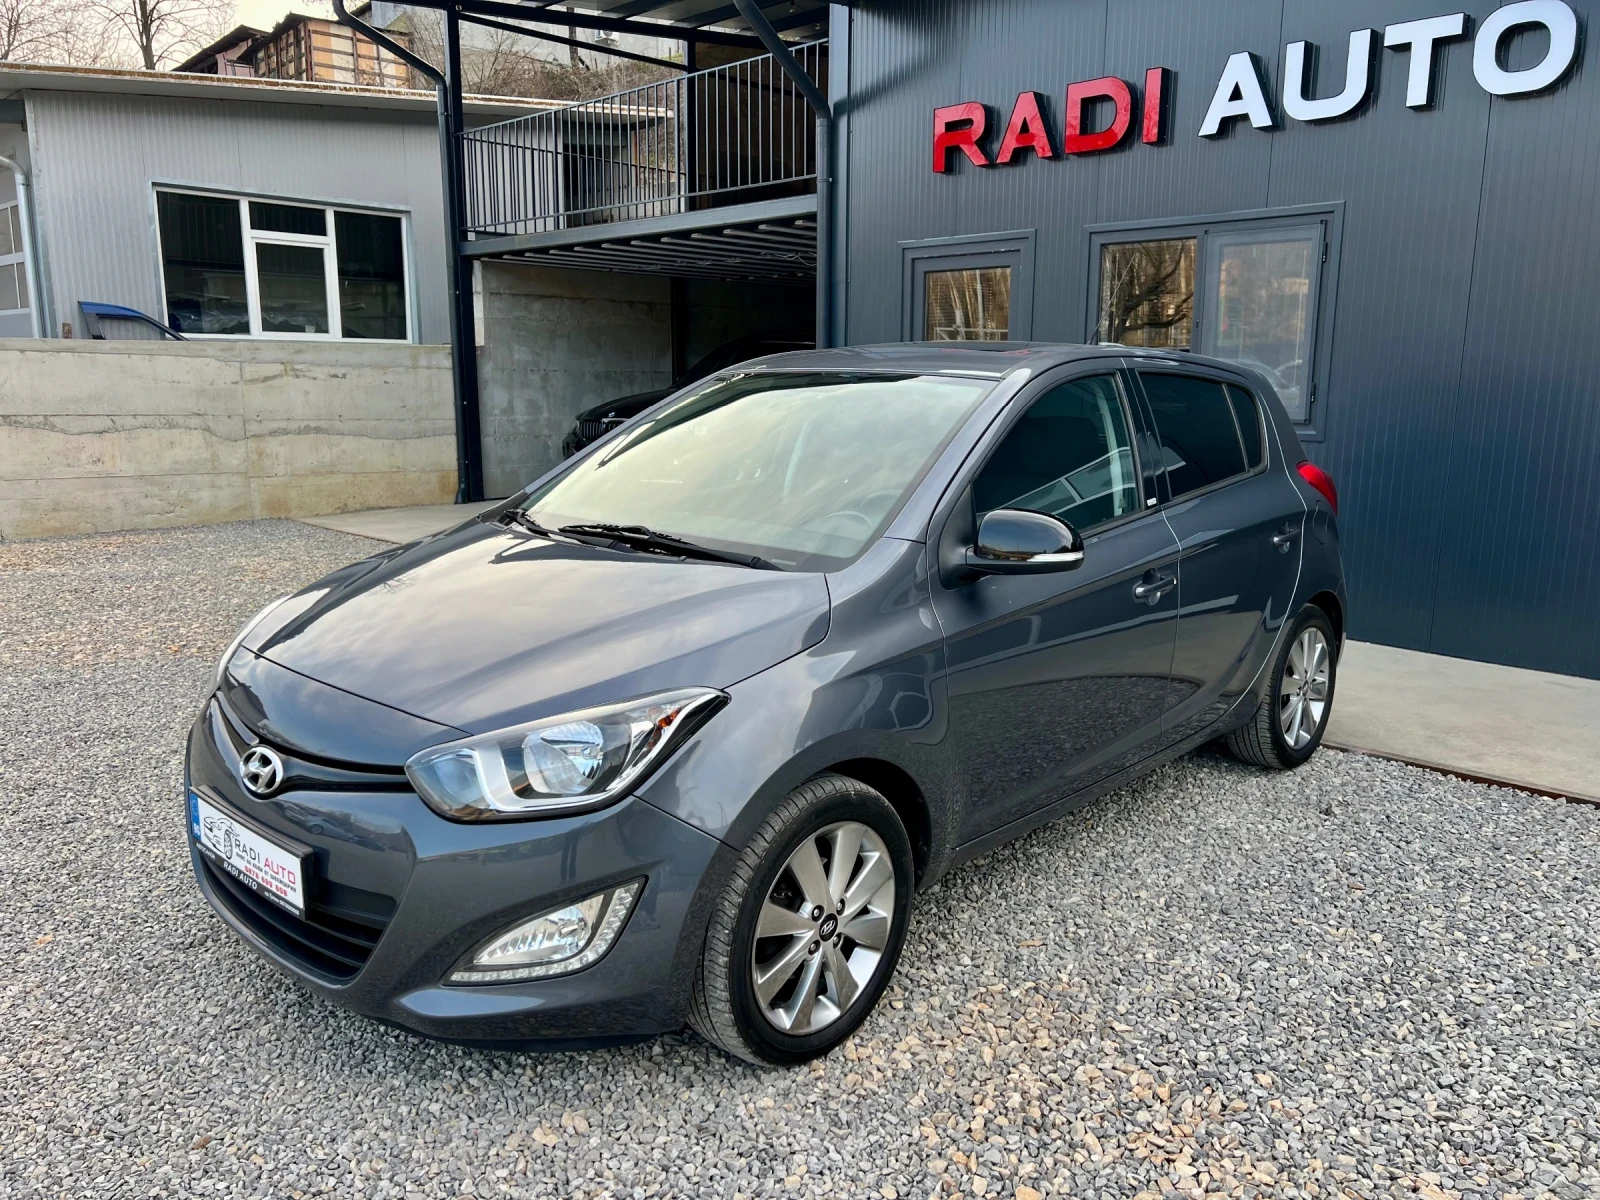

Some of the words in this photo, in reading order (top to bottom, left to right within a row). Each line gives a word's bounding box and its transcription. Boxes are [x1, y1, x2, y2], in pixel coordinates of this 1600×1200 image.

[932, 66, 1172, 174] RADI
[1198, 0, 1580, 139] AUTO
[223, 861, 239, 877] RADI
[239, 873, 258, 890] AUTO
[235, 838, 261, 864] RADI
[264, 857, 296, 885] AUTO
